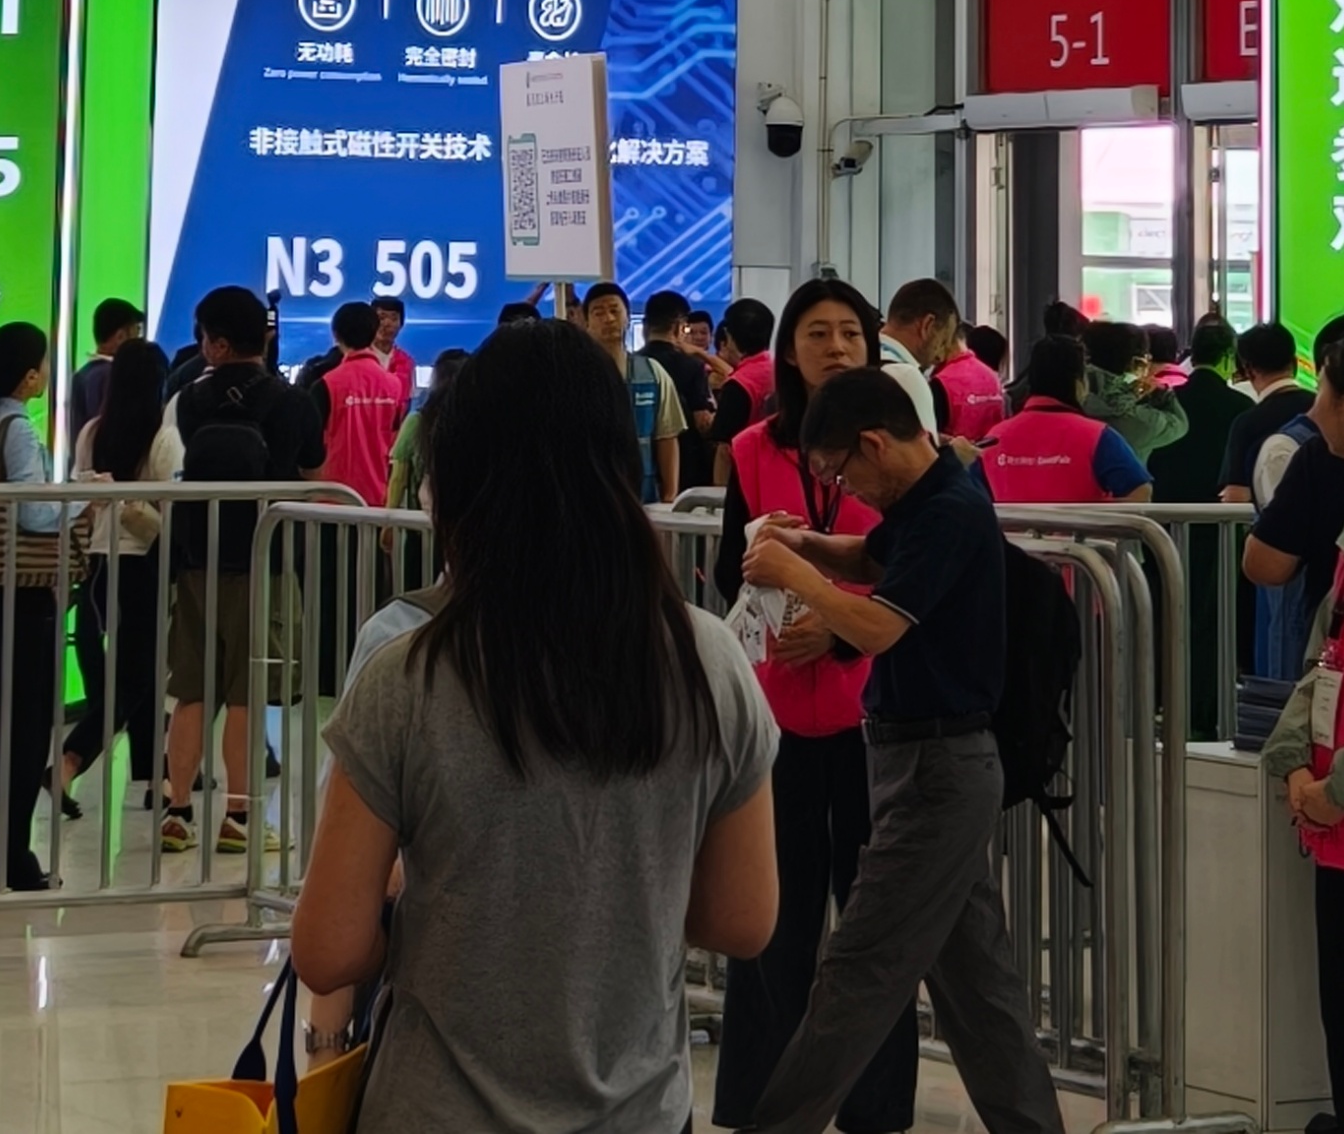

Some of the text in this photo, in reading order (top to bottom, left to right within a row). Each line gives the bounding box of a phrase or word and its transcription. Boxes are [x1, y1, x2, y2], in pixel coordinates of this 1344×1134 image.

[296, 41, 354, 64] 无功耗
[405, 46, 477, 69] 完全密封
[1049, 11, 1110, 69] 5-1
[249, 126, 493, 162] 非接触式磁性开关技术
[265, 235, 479, 300] N3 505
